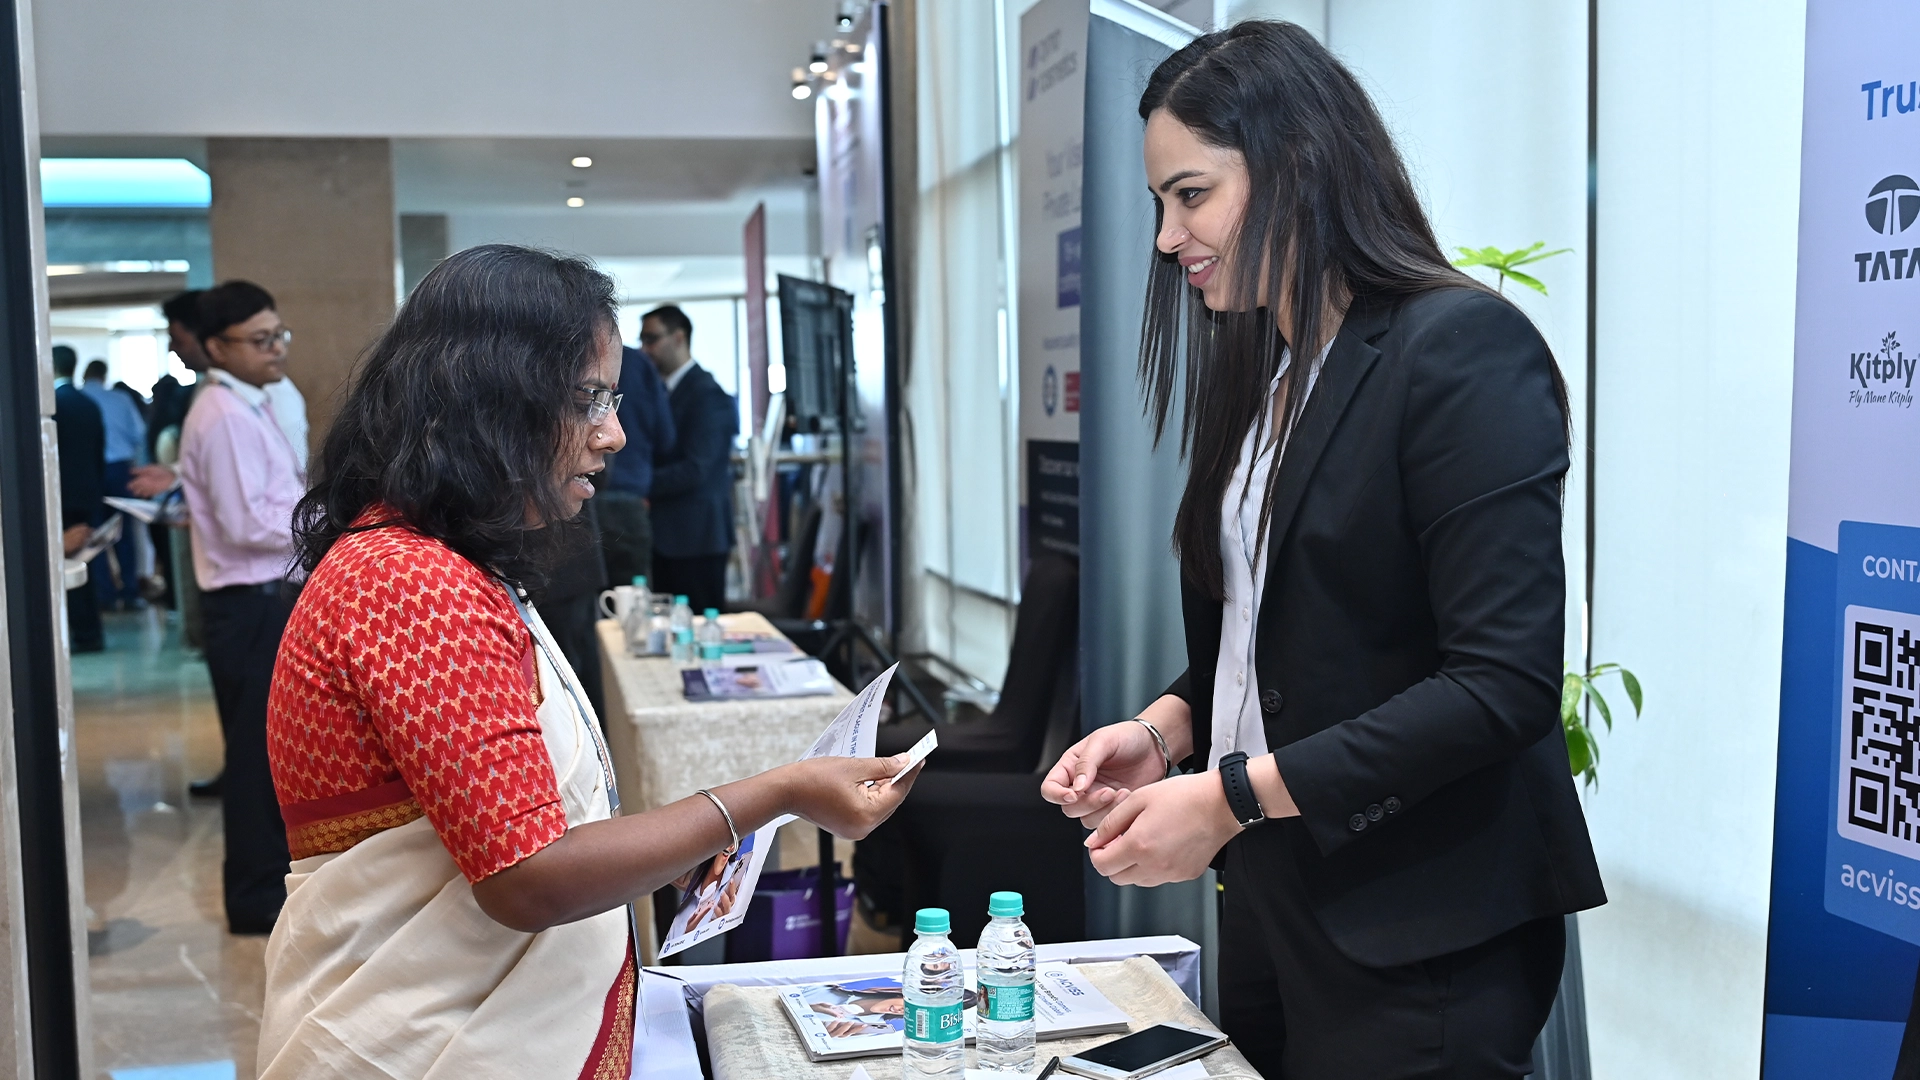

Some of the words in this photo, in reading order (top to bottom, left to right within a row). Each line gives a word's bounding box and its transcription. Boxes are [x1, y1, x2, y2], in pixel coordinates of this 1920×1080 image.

[1861, 80, 1920, 120] Tru
[1855, 248, 1920, 282] TATA
[1850, 352, 1917, 388] Kitply
[1849, 389, 1862, 408] Ply
[1888, 389, 1913, 409] Kitply
[1863, 555, 1920, 583] CONT
[1841, 864, 1920, 910] acviss
